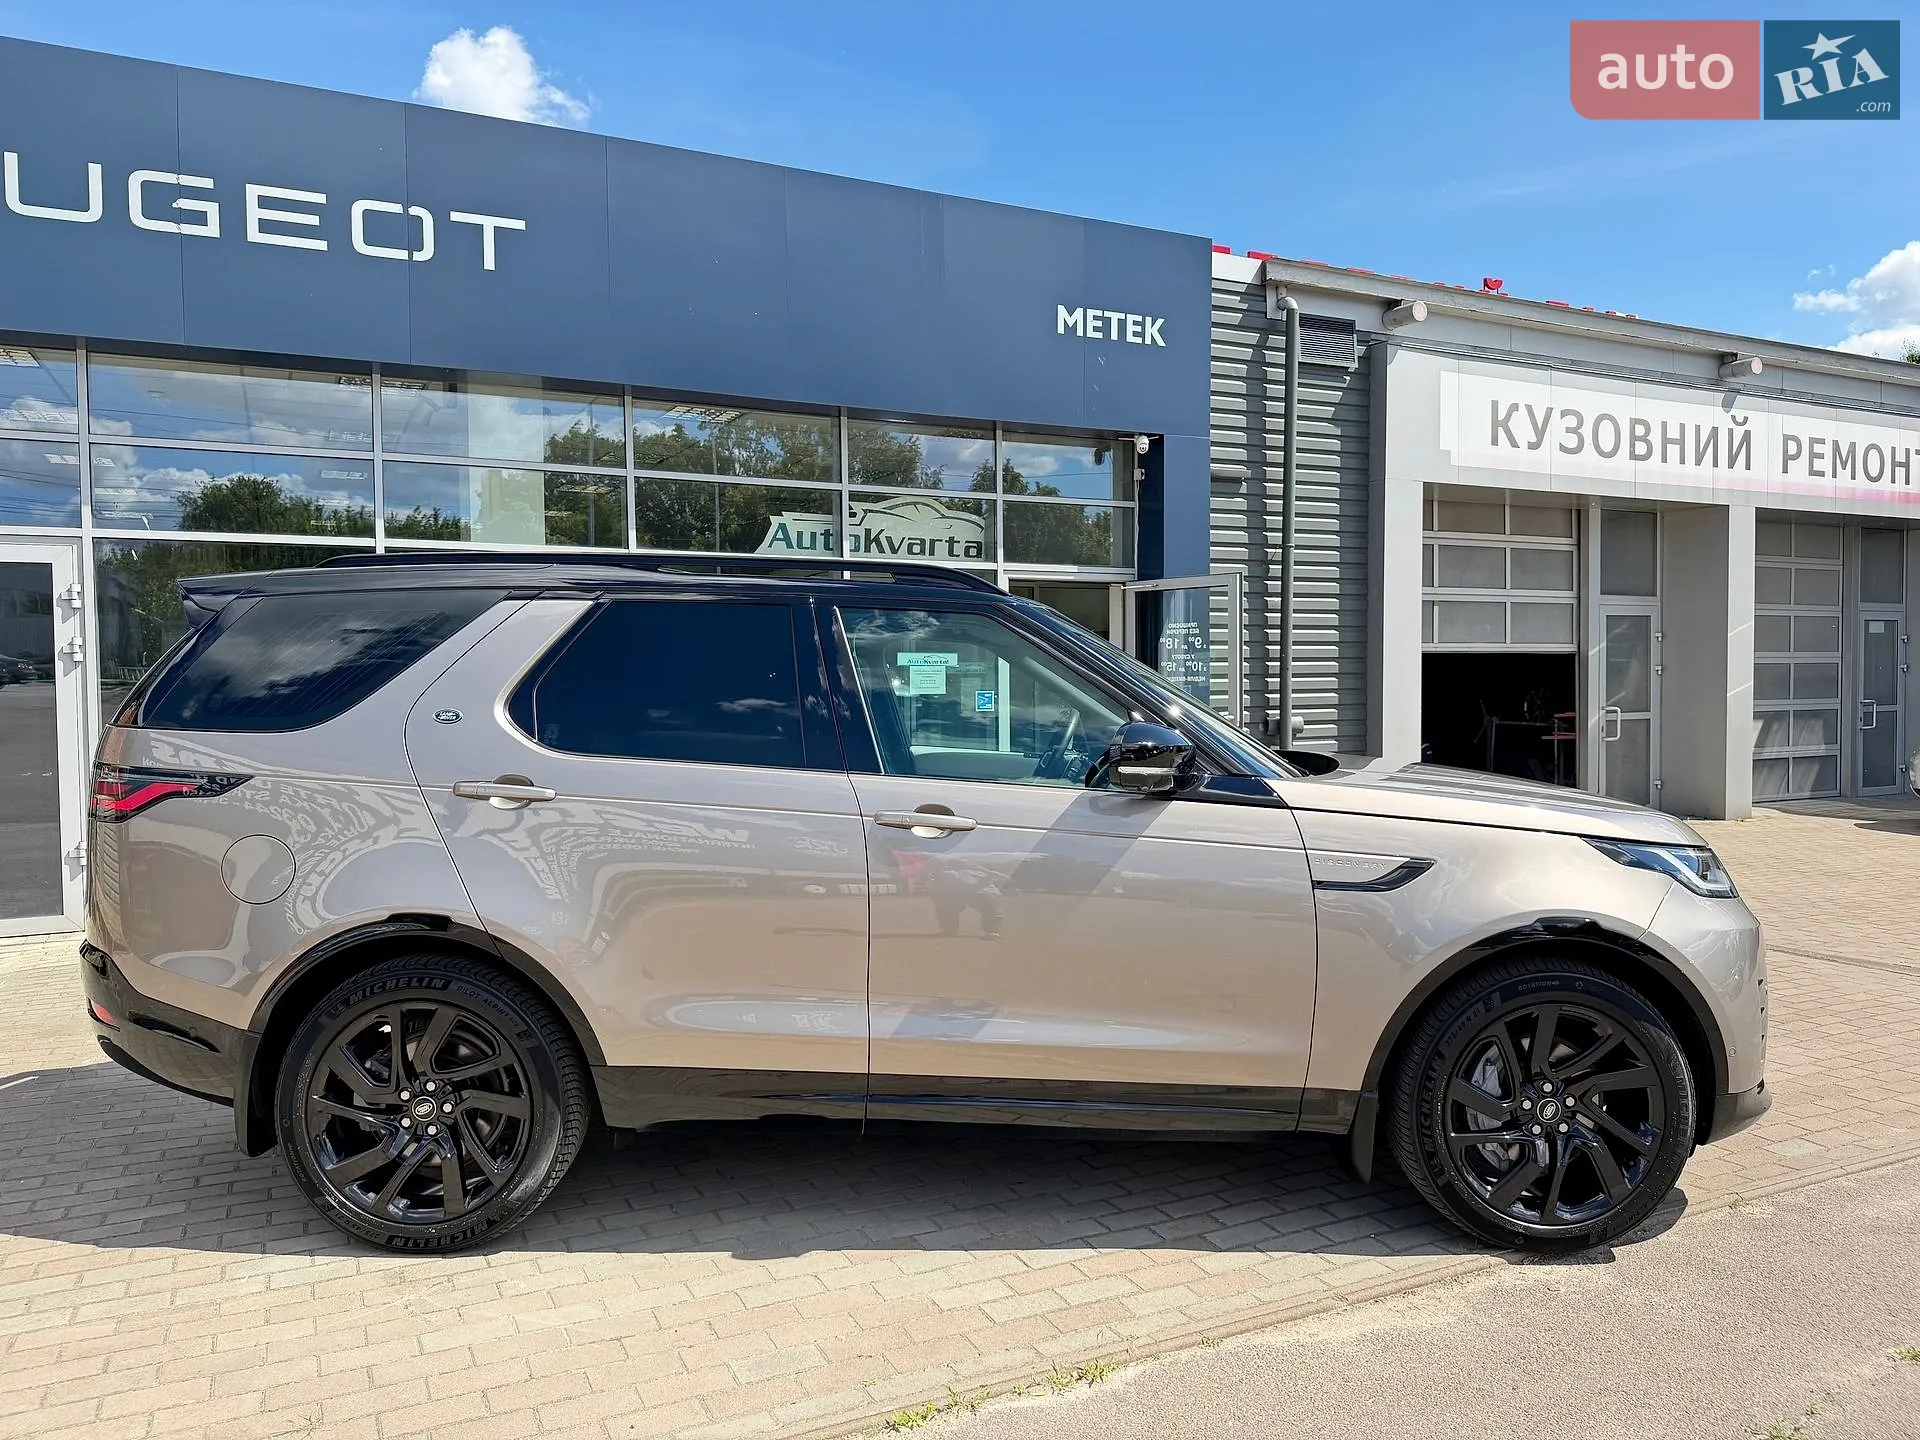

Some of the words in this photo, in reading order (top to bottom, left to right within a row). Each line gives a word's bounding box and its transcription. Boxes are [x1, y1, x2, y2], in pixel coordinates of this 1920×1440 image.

[3, 151, 526, 271] UGEOT
[1057, 304, 1167, 347] METEK
[1490, 400, 1752, 471] КУЗОВНИЙ
[1782, 434, 1920, 486] РЕМОН
[349, 977, 446, 1005] MICHELIN
